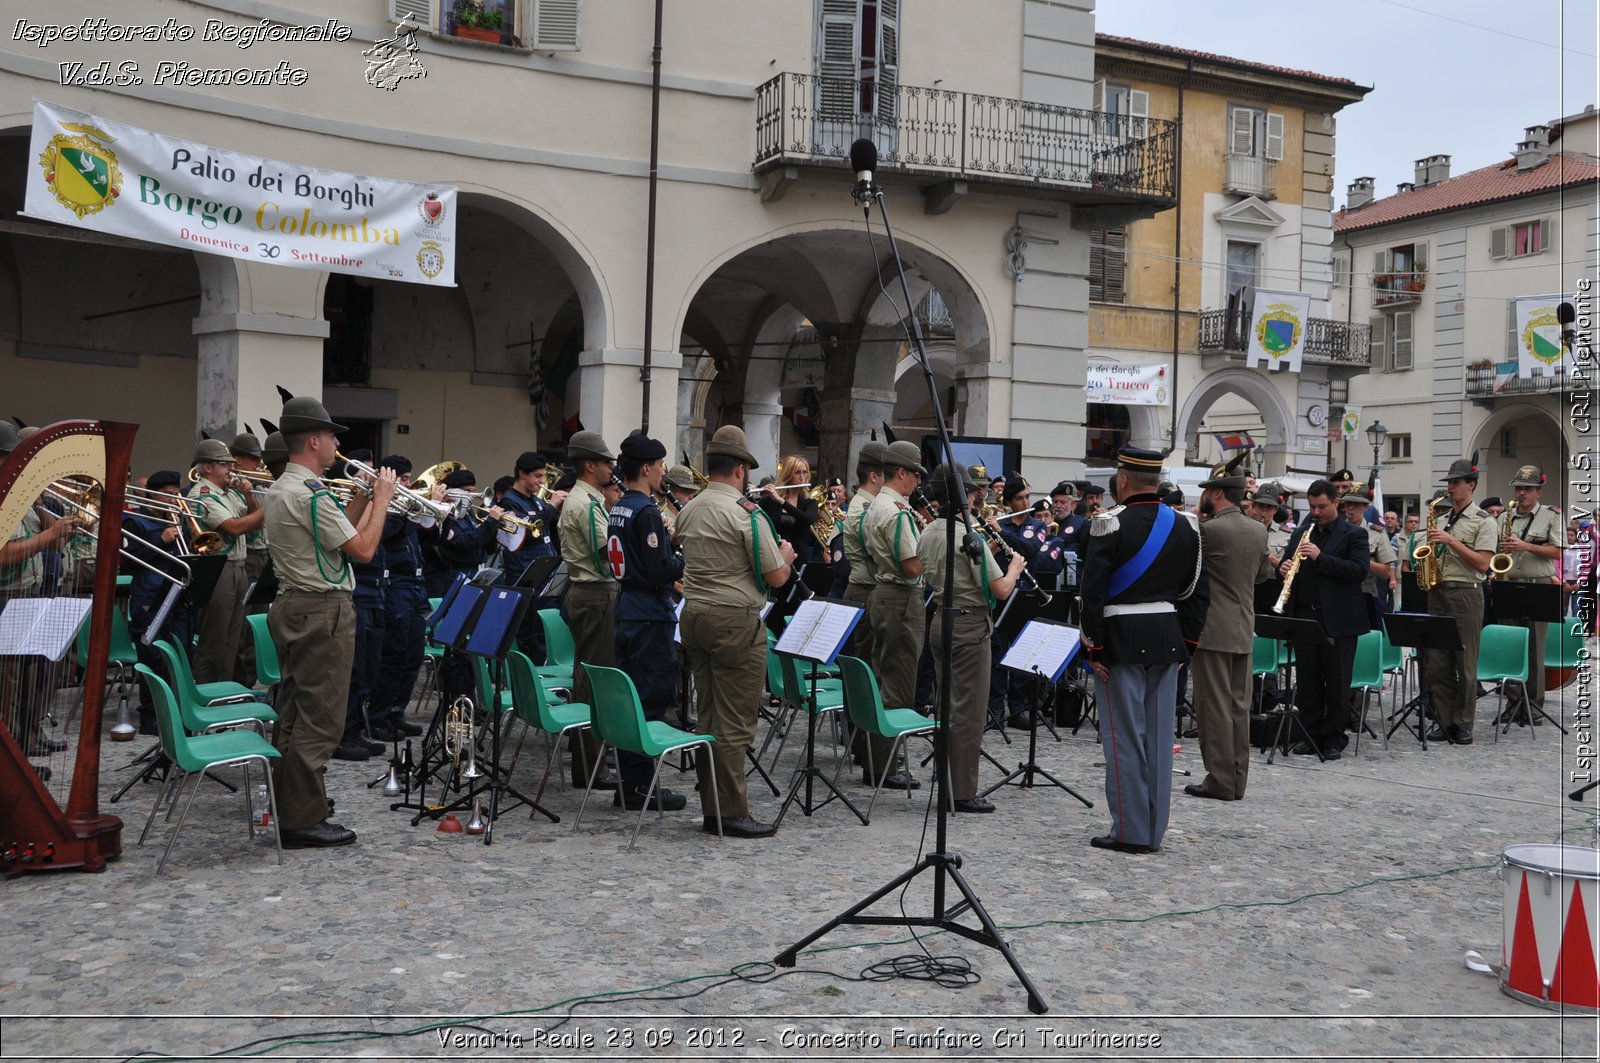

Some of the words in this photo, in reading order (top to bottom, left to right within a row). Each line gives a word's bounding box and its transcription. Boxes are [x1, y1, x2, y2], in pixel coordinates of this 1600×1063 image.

[171, 149, 236, 182] Palio
[248, 166, 283, 193] dei
[294, 174, 374, 210] Borghi
[138, 174, 243, 229] Borgo
[255, 201, 400, 246] Colomba
[180, 227, 249, 253] Domenica
[257, 243, 281, 259] 30
[291, 249, 364, 268] Settembre
[1095, 364, 1109, 373] dei
[1111, 365, 1141, 377] Borghi
[1106, 377, 1149, 391] Trucco
